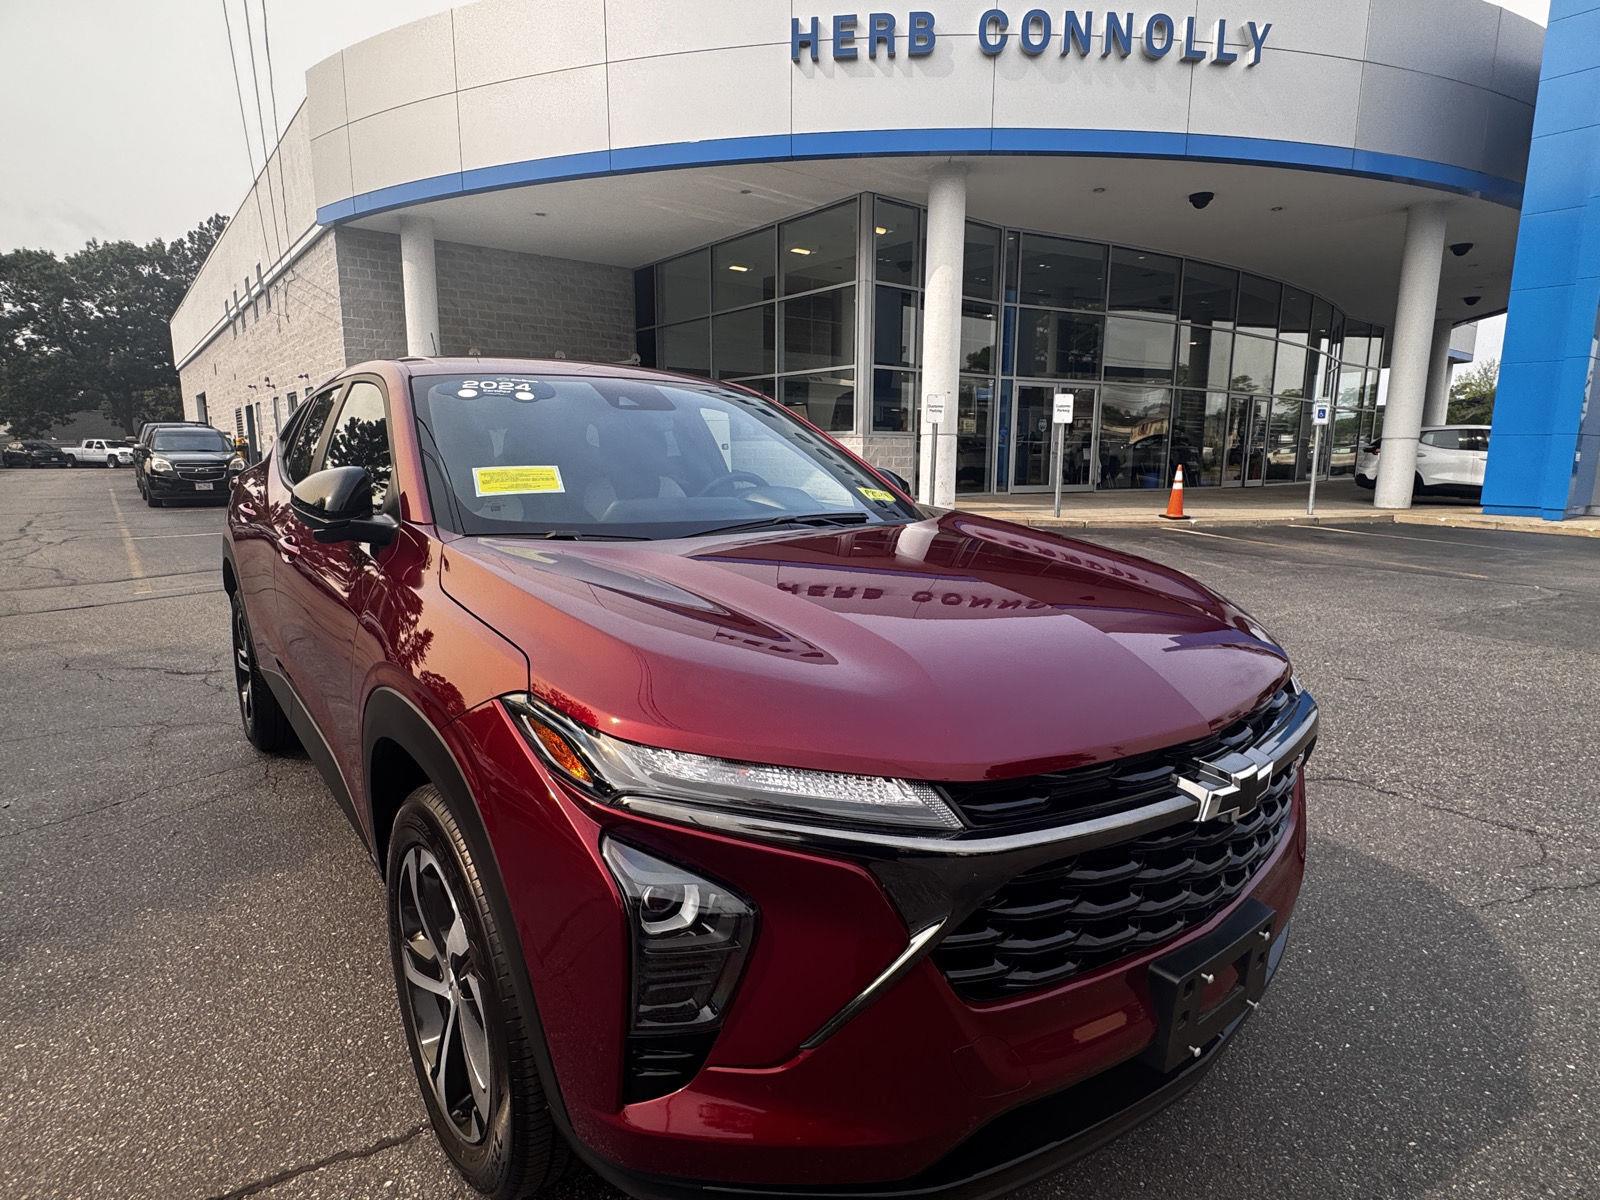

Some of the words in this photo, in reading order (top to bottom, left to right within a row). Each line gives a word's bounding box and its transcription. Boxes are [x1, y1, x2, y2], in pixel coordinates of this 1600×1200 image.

[791, 11, 936, 62] HERB
[978, 9, 1272, 66] CONNOLLY
[462, 380, 531, 391] 2024
